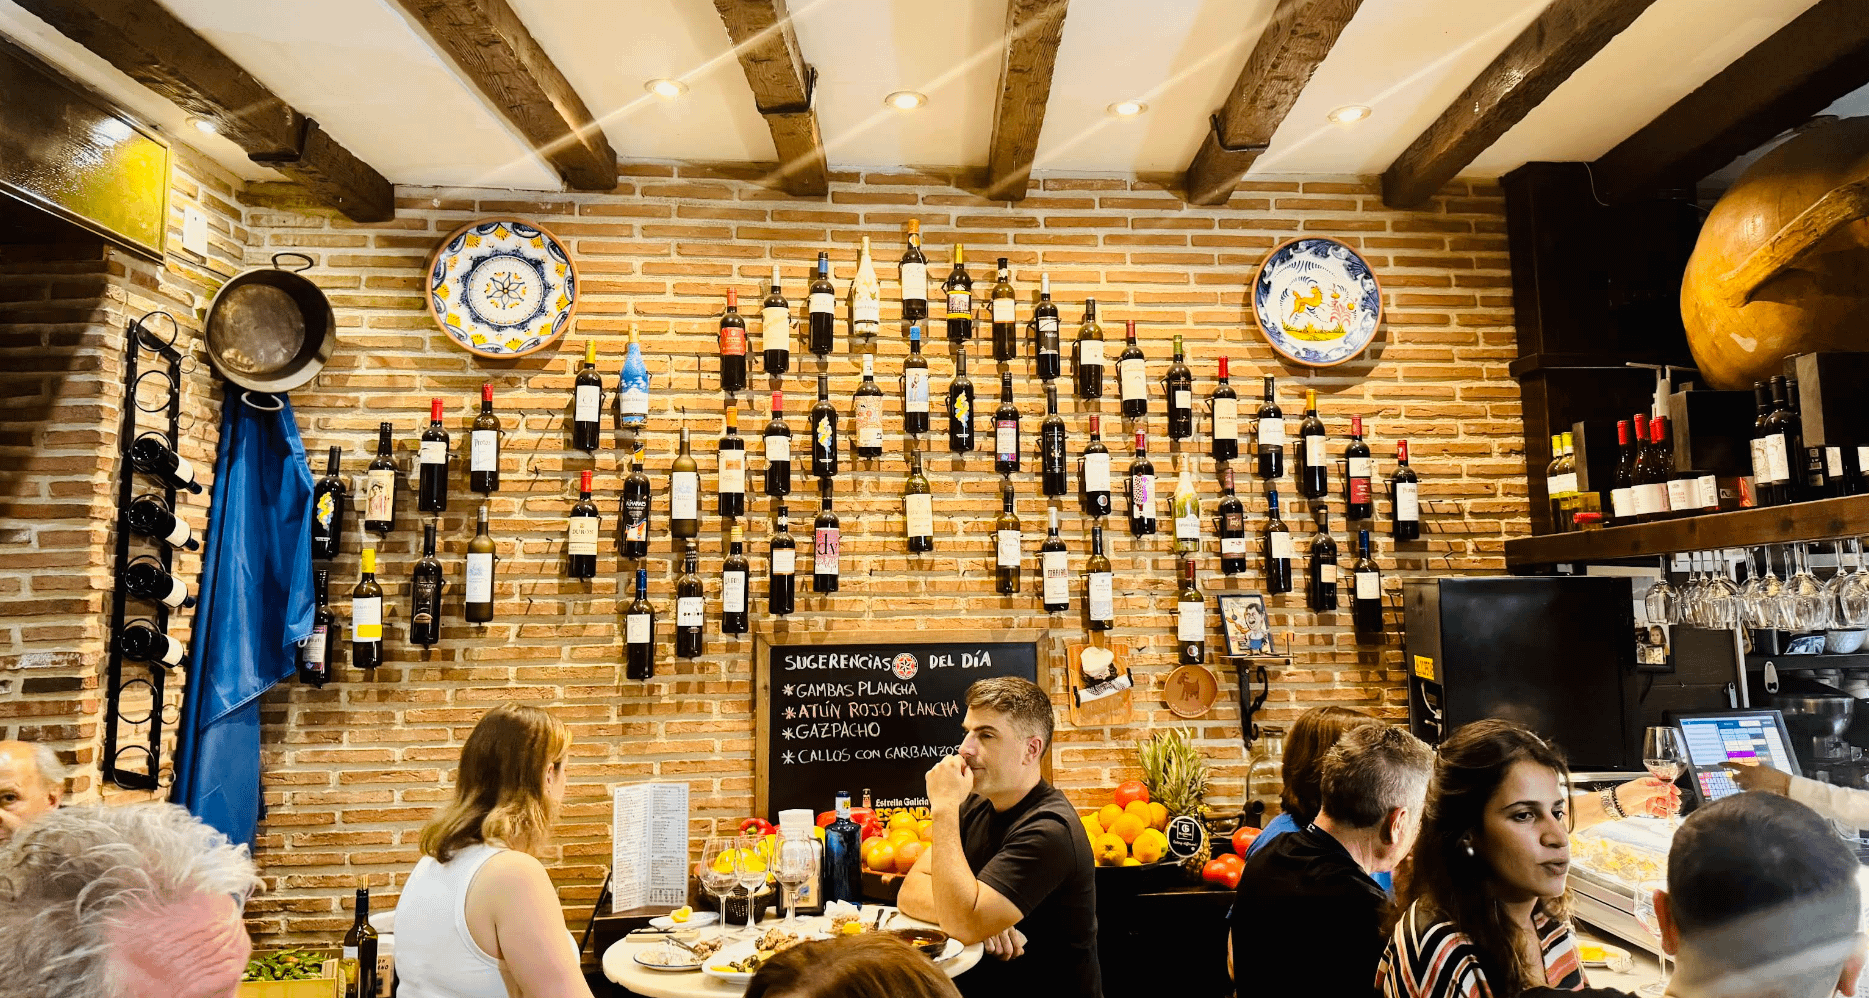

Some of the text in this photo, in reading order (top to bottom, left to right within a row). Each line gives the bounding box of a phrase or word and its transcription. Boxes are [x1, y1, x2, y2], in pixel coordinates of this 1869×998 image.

[929, 654, 955, 669] DEL
[796, 681, 918, 698] GAMBAS PLANCHA
[799, 700, 960, 719] ATÚN ROJO PLANCHA
[795, 721, 881, 739] GAZPACHO
[798, 748, 850, 764] CALLOS
[855, 749, 881, 760] CON
[875, 797, 929, 807] Estrella Galicia
